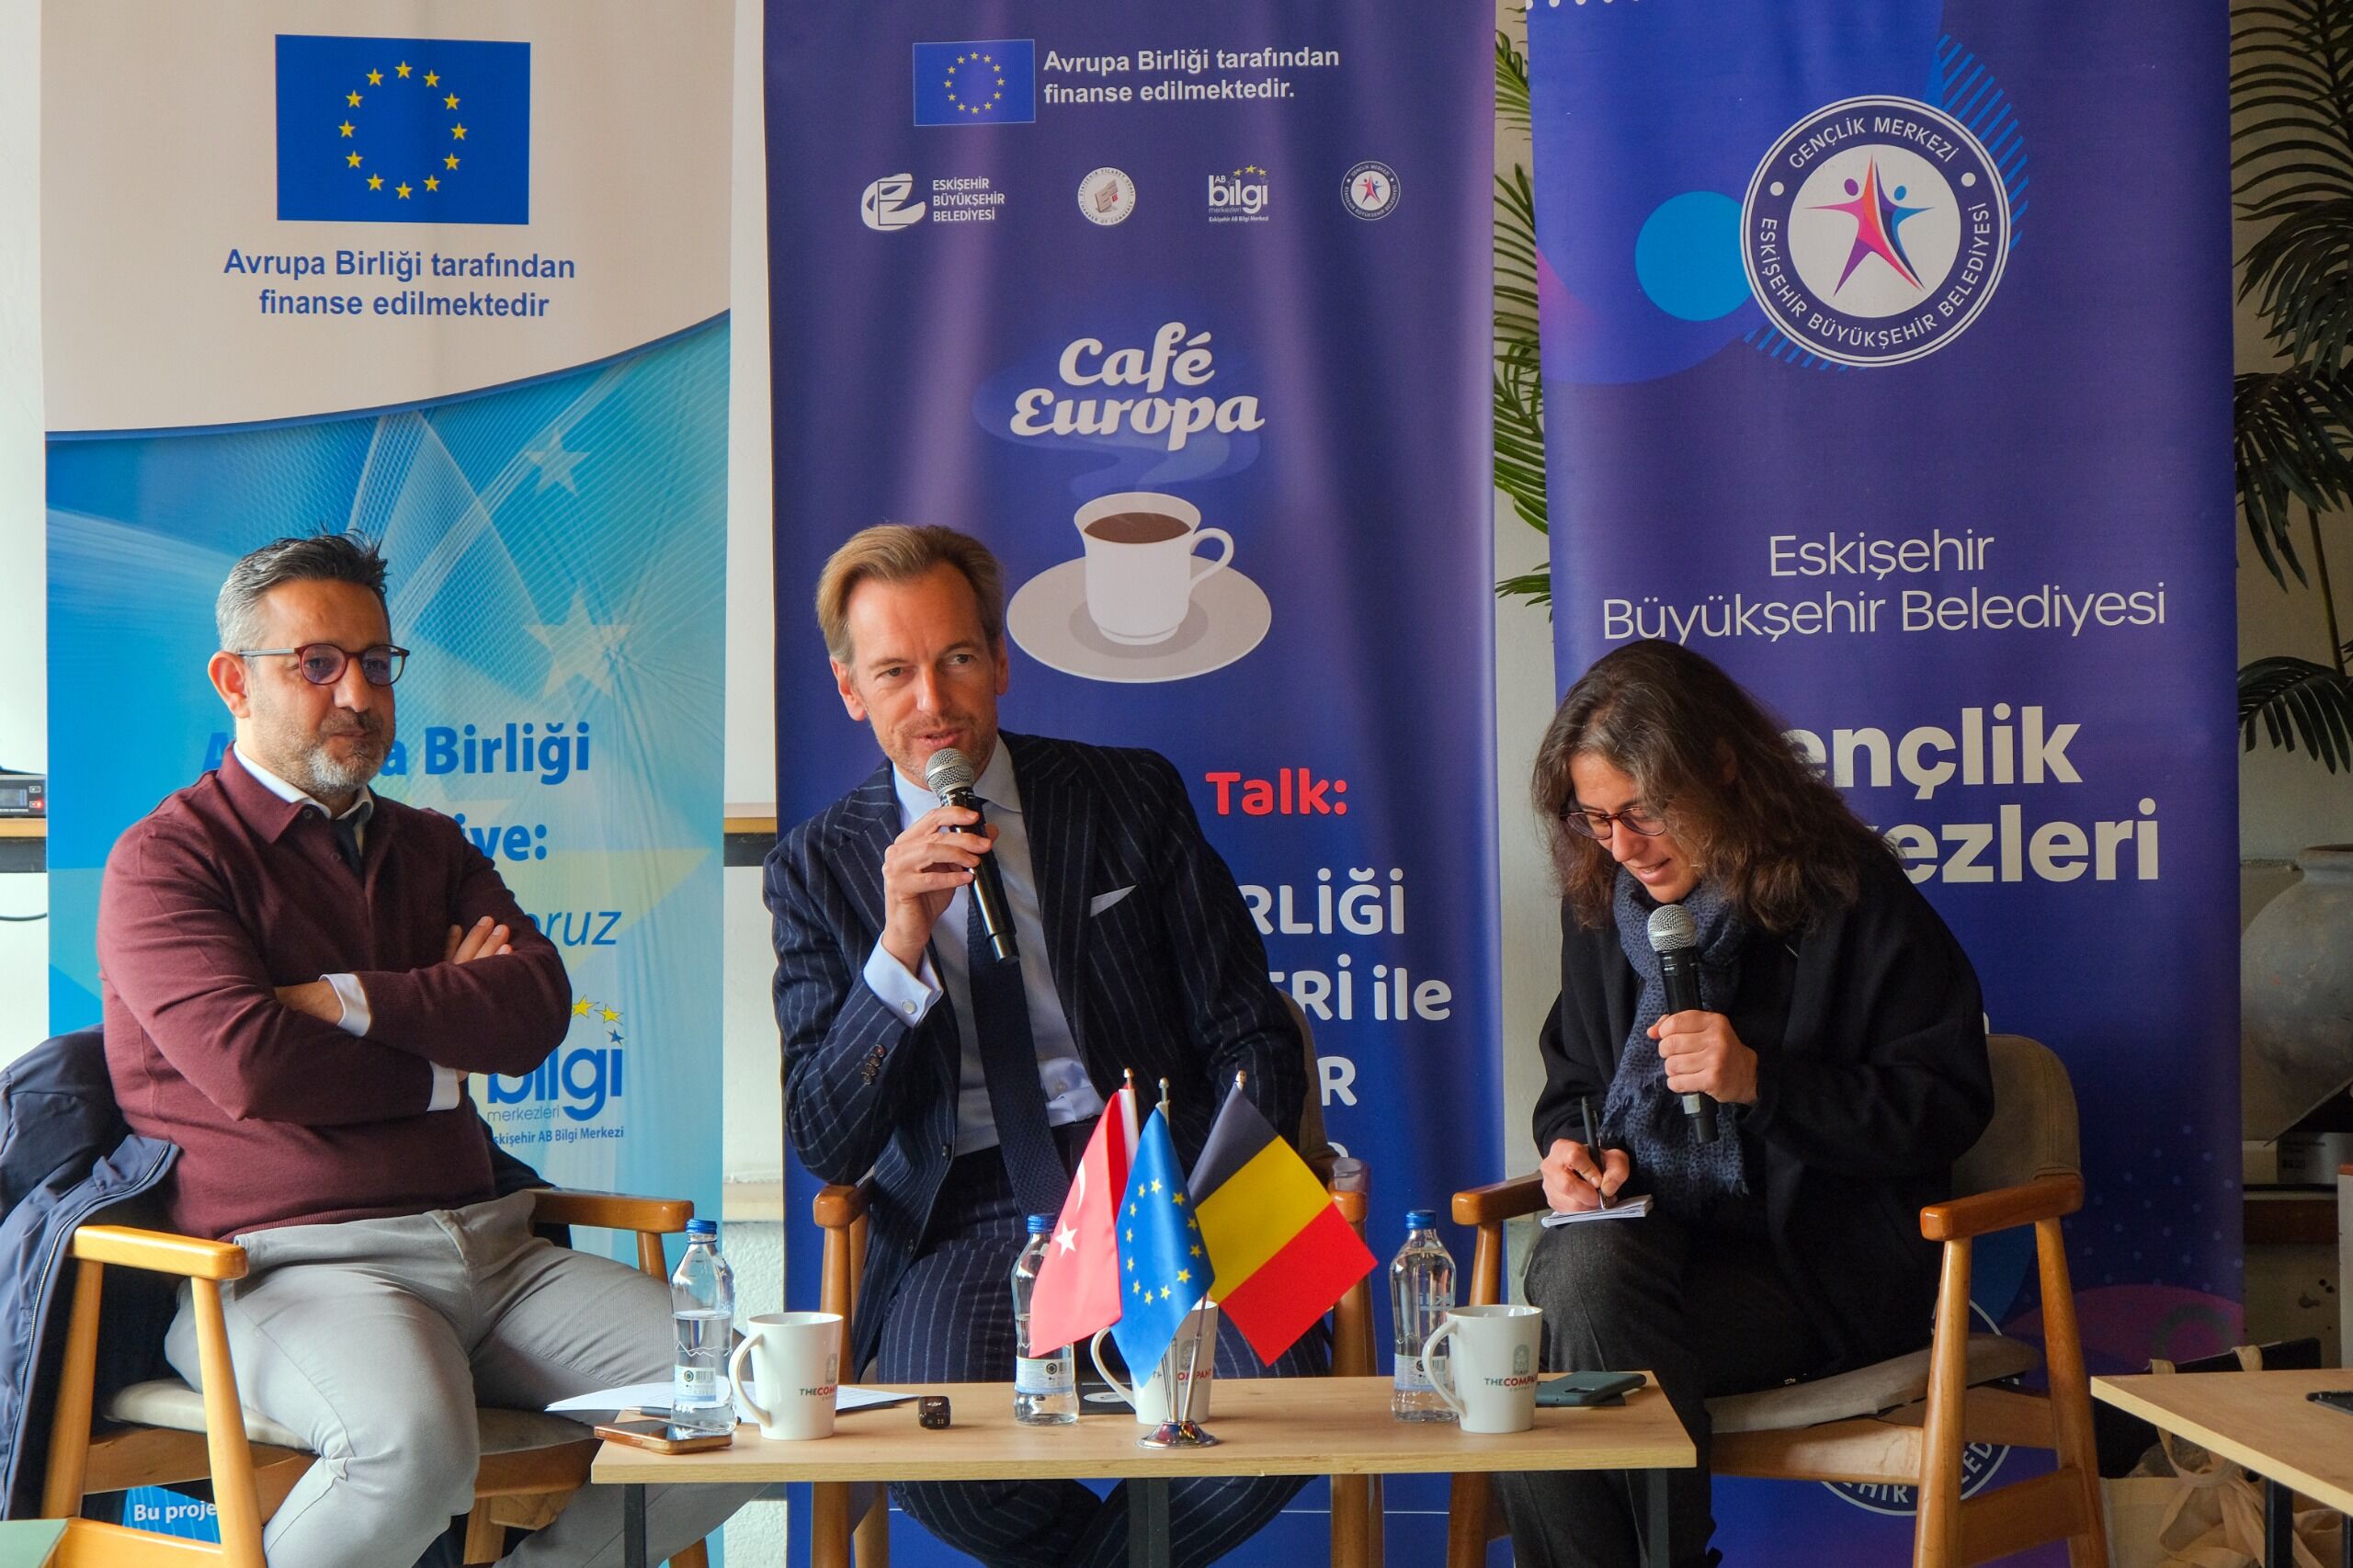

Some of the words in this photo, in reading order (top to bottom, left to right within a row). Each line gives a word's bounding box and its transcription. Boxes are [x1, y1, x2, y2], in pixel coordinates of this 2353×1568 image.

[1043, 50, 1130, 76] Avrupa
[1138, 47, 1210, 75] Birliği
[1216, 46, 1339, 70] tarafından
[1043, 81, 1132, 104] finanse
[1140, 78, 1295, 102] edilmektedir.
[1789, 117, 1866, 168] GENÇLİK
[1873, 116, 1961, 163] MERKEZİ
[933, 176, 990, 191] ESKİŞEHİR
[933, 191, 1005, 208] BÜYÜKŞEHİR
[933, 207, 995, 222] BELEDİYESİ
[223, 249, 325, 279] Avrupa
[336, 250, 422, 281] Birliği
[431, 252, 575, 279] tarafından
[1759, 217, 1808, 319] ESKİŞEHİR
[1807, 312, 1938, 349] BÜYÜKŞEHİR
[1938, 202, 1991, 317] BELEDİYESİ
[259, 290, 363, 315] finanse
[372, 291, 550, 318] edilmektedir
[1059, 322, 1215, 393] Café
[1010, 388, 1266, 451] Europa
[1769, 528, 1995, 581] Eskişehir
[1604, 591, 1886, 645] Büyükşehir
[1901, 582, 2166, 637] Belediyesi
[424, 722, 591, 785] Birliği
[1206, 768, 1347, 815] Talk:
[1866, 798, 2160, 883] ezleri
[1268, 953, 1353, 1021] Rİ
[1373, 964, 1452, 1021] ile
[487, 1105, 560, 1121] merkezleri
[538, 1131, 552, 1142] AB
[555, 1128, 577, 1143] Bilgi
[580, 1126, 624, 1140] Merkezi
[133, 1504, 160, 1521] Bu
[165, 1501, 216, 1524] proje
